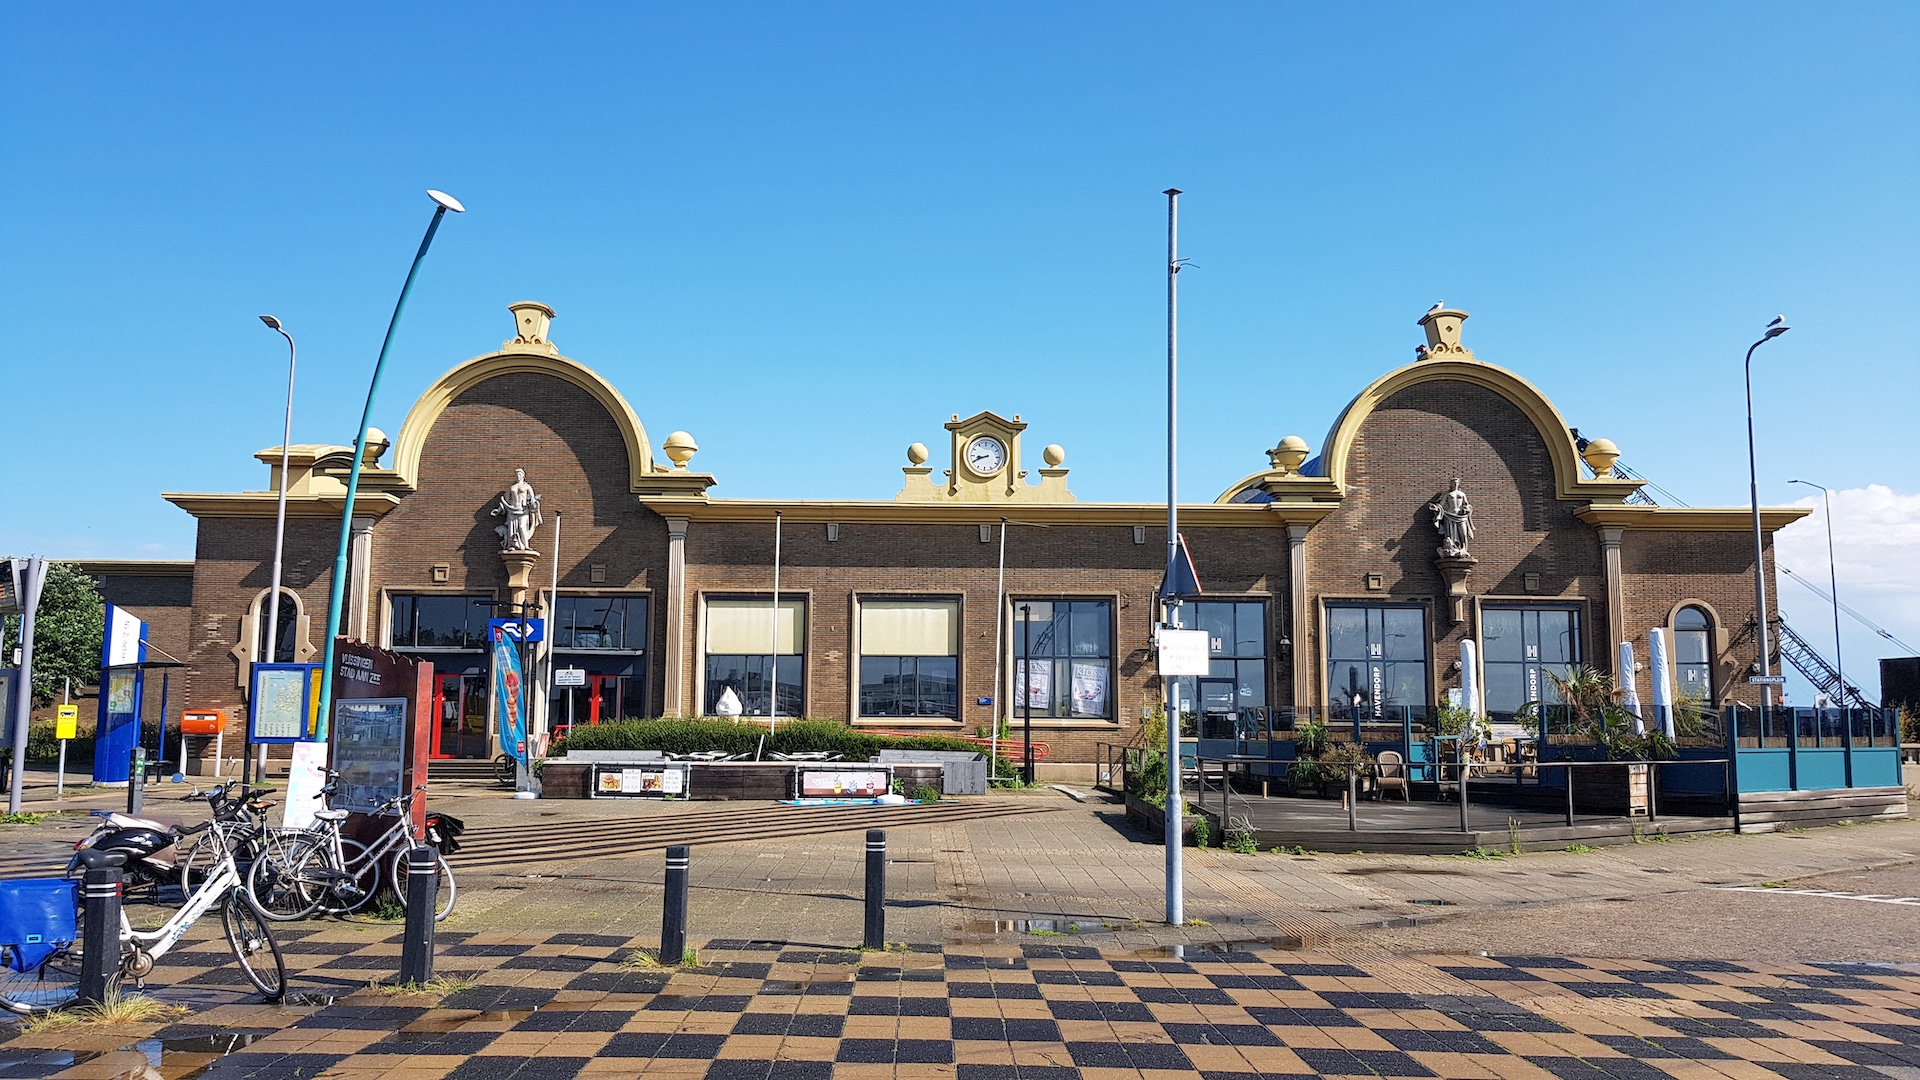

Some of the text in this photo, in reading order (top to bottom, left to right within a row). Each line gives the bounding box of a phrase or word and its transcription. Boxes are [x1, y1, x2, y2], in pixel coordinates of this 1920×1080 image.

[341, 652, 374, 670] VLISSINGEN
[340, 665, 382, 685] STAD AAN ZEE
[1373, 666, 1382, 717] HAVENDORP
